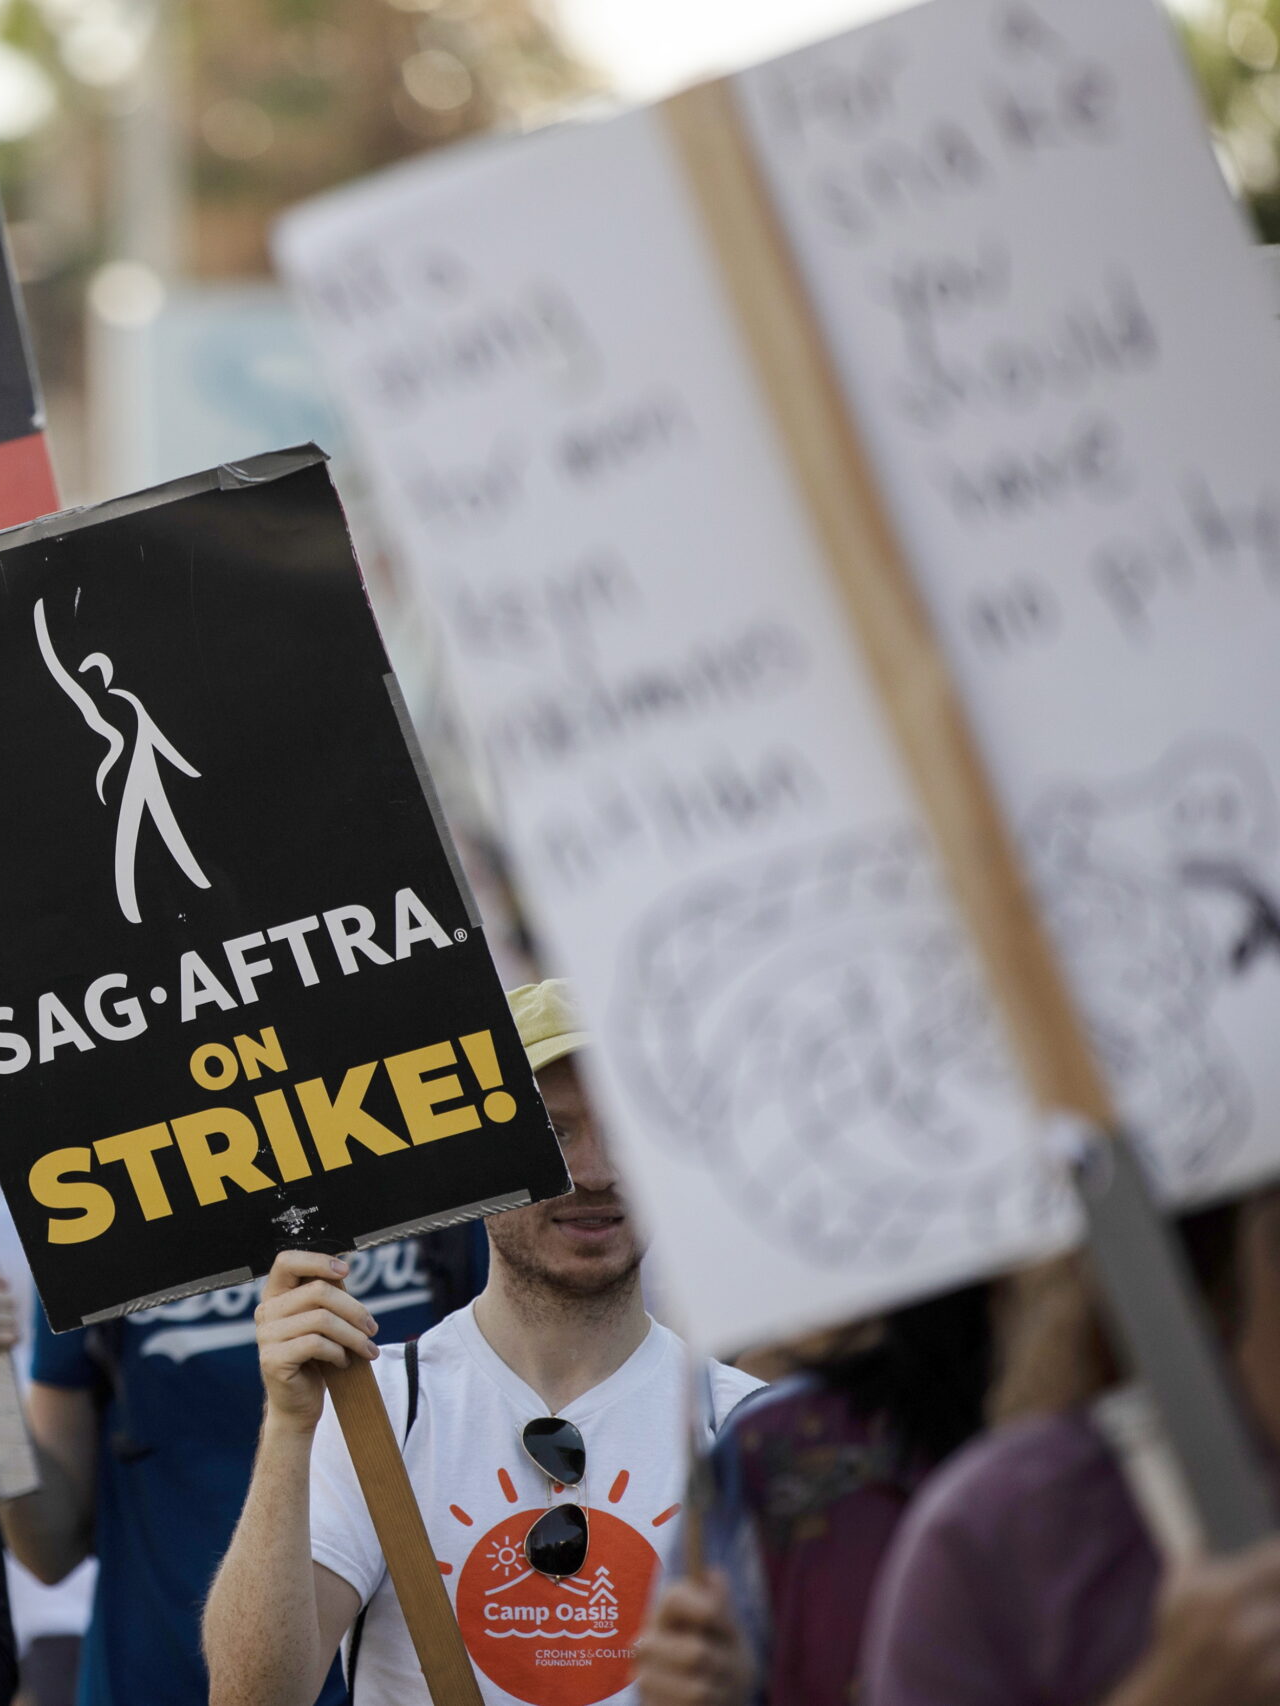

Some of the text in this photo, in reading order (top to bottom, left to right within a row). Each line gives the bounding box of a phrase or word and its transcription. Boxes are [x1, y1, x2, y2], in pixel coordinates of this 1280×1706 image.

[189, 1025, 288, 1091] ON
[28, 1029, 516, 1244] STRIKE!
[483, 1599, 619, 1625] Camp Oasis
[593, 1620, 614, 1628] 2023
[535, 1649, 586, 1659] CROHN'S
[535, 1659, 592, 1667] FOUNDATION
